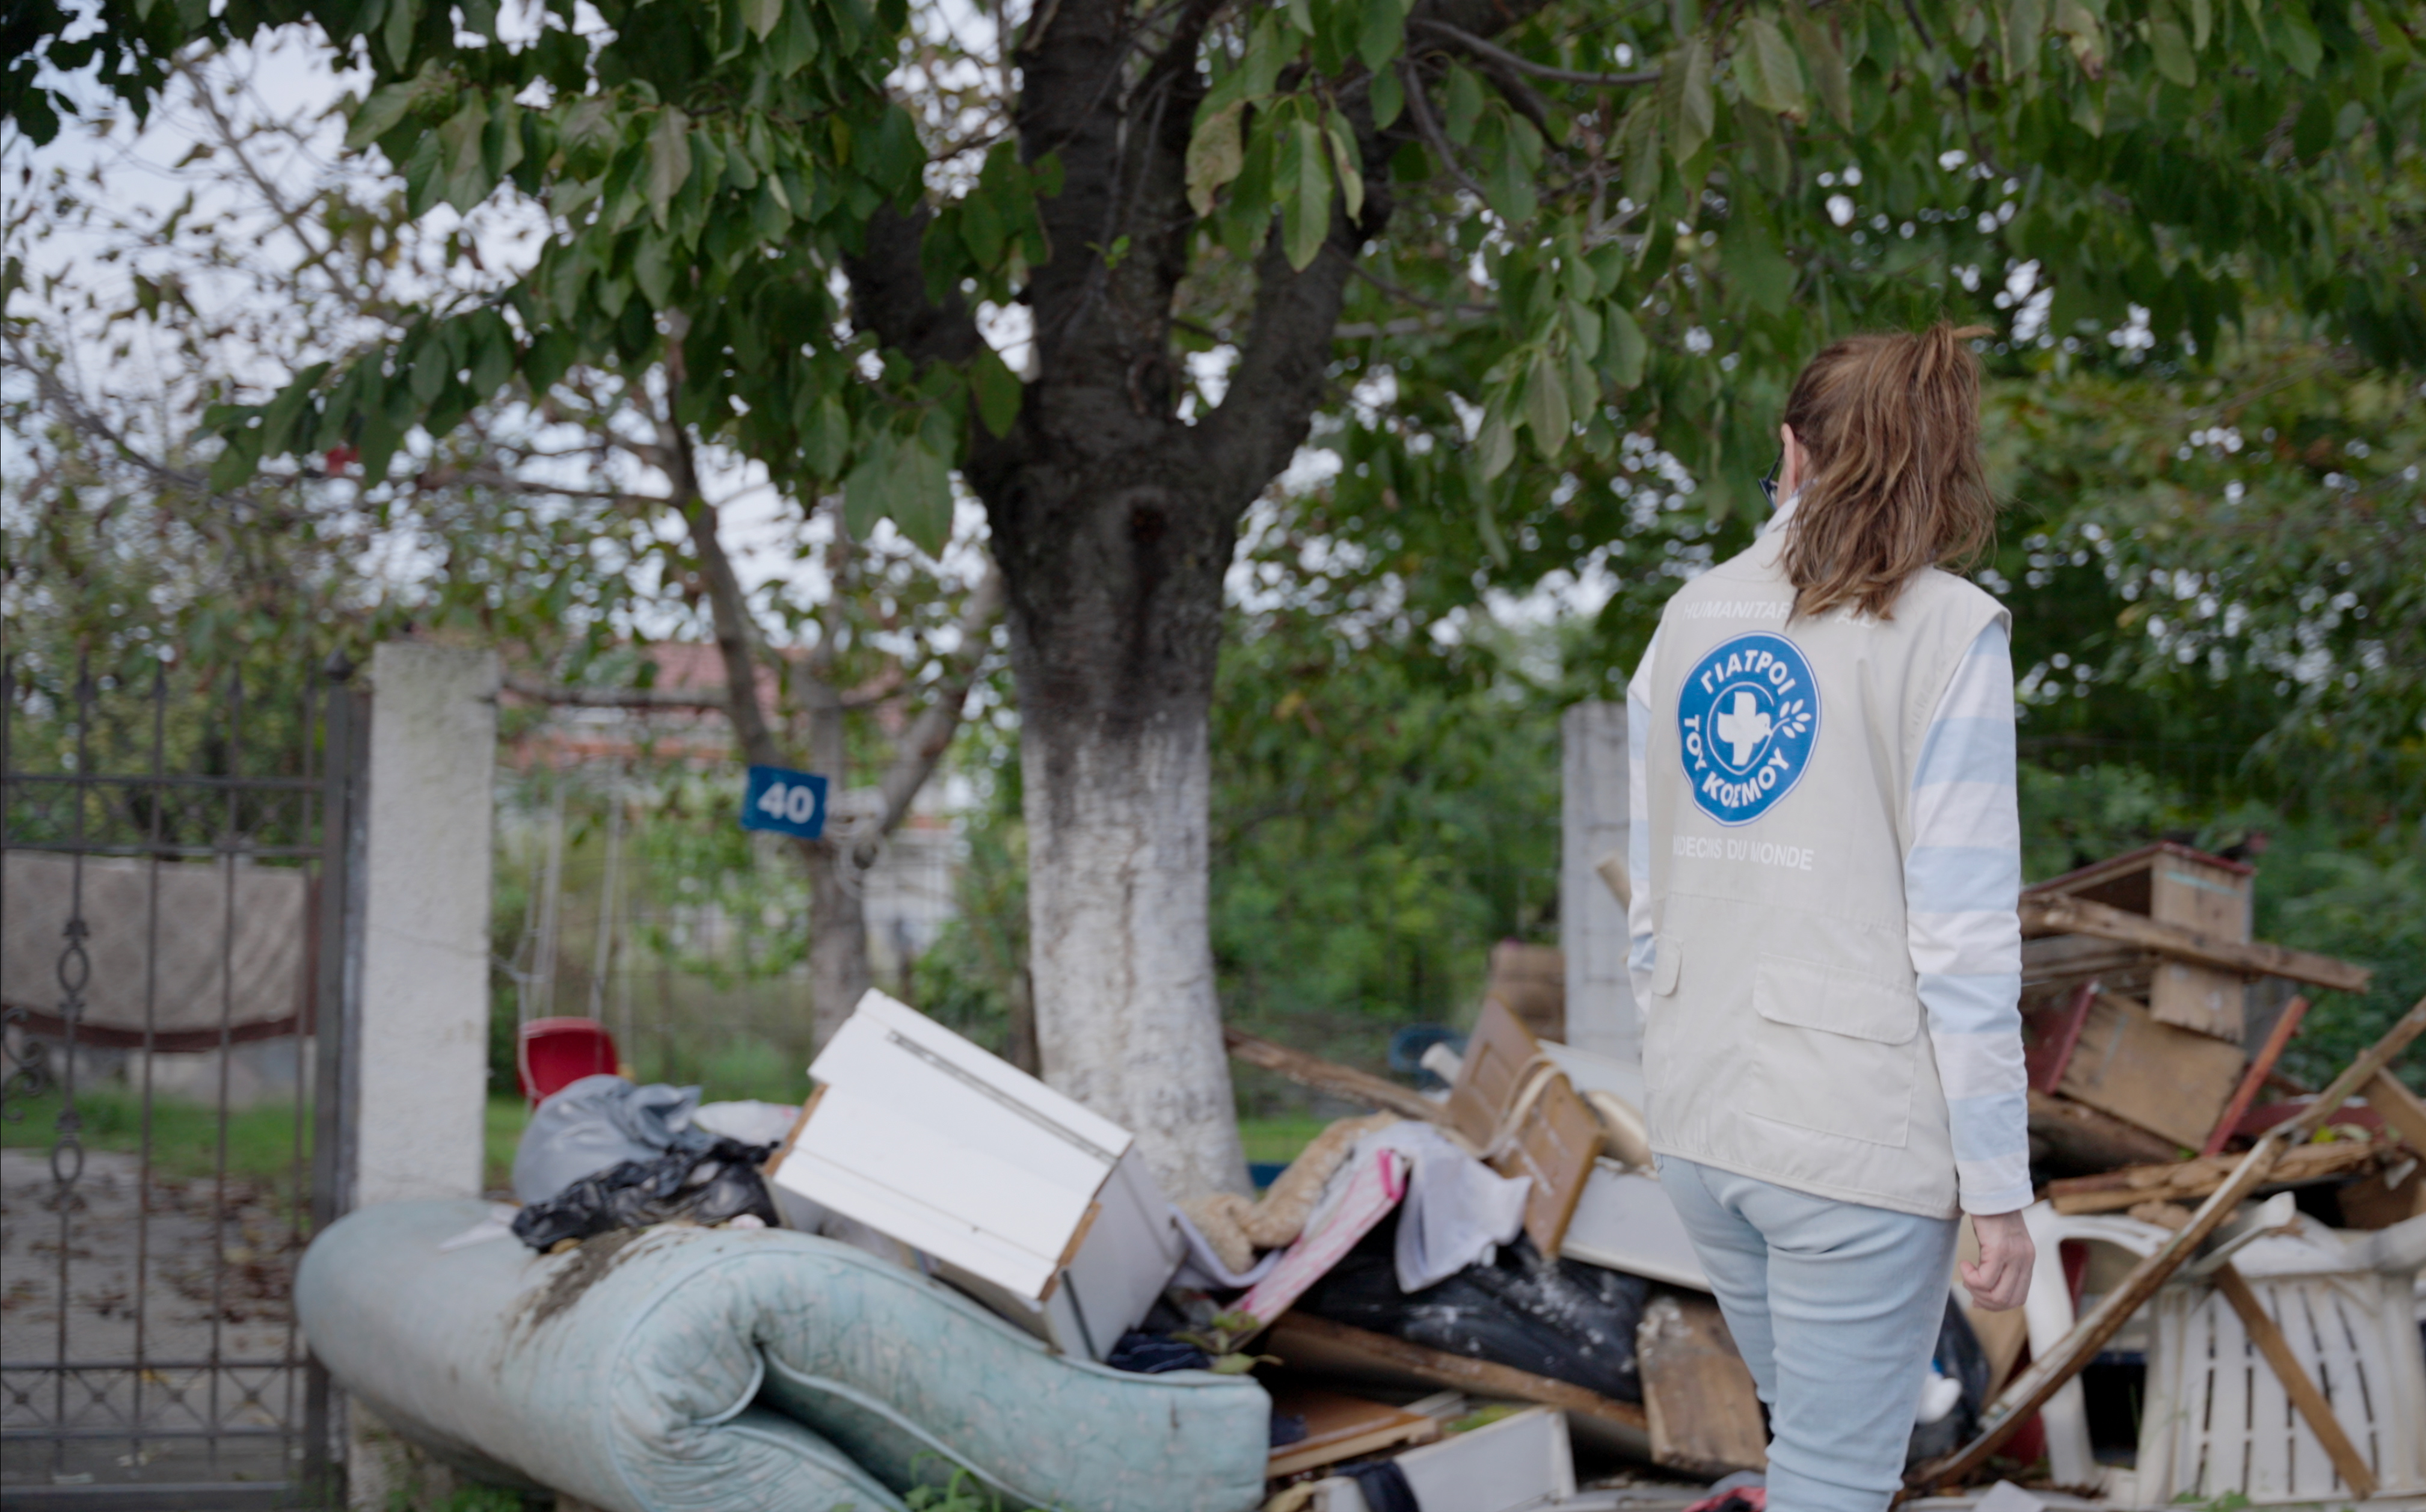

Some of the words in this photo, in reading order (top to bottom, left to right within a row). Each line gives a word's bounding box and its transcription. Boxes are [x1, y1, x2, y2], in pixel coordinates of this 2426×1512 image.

[1700, 649, 1796, 695] ΓΙΑΤΡΟΙ
[1684, 714, 1707, 771] ΤΟΥ
[1701, 746, 1790, 808] ΚΟΣΜΟΥ
[757, 781, 816, 825] 40
[1727, 838, 1748, 861] DU
[1749, 840, 1814, 871] MONDE
